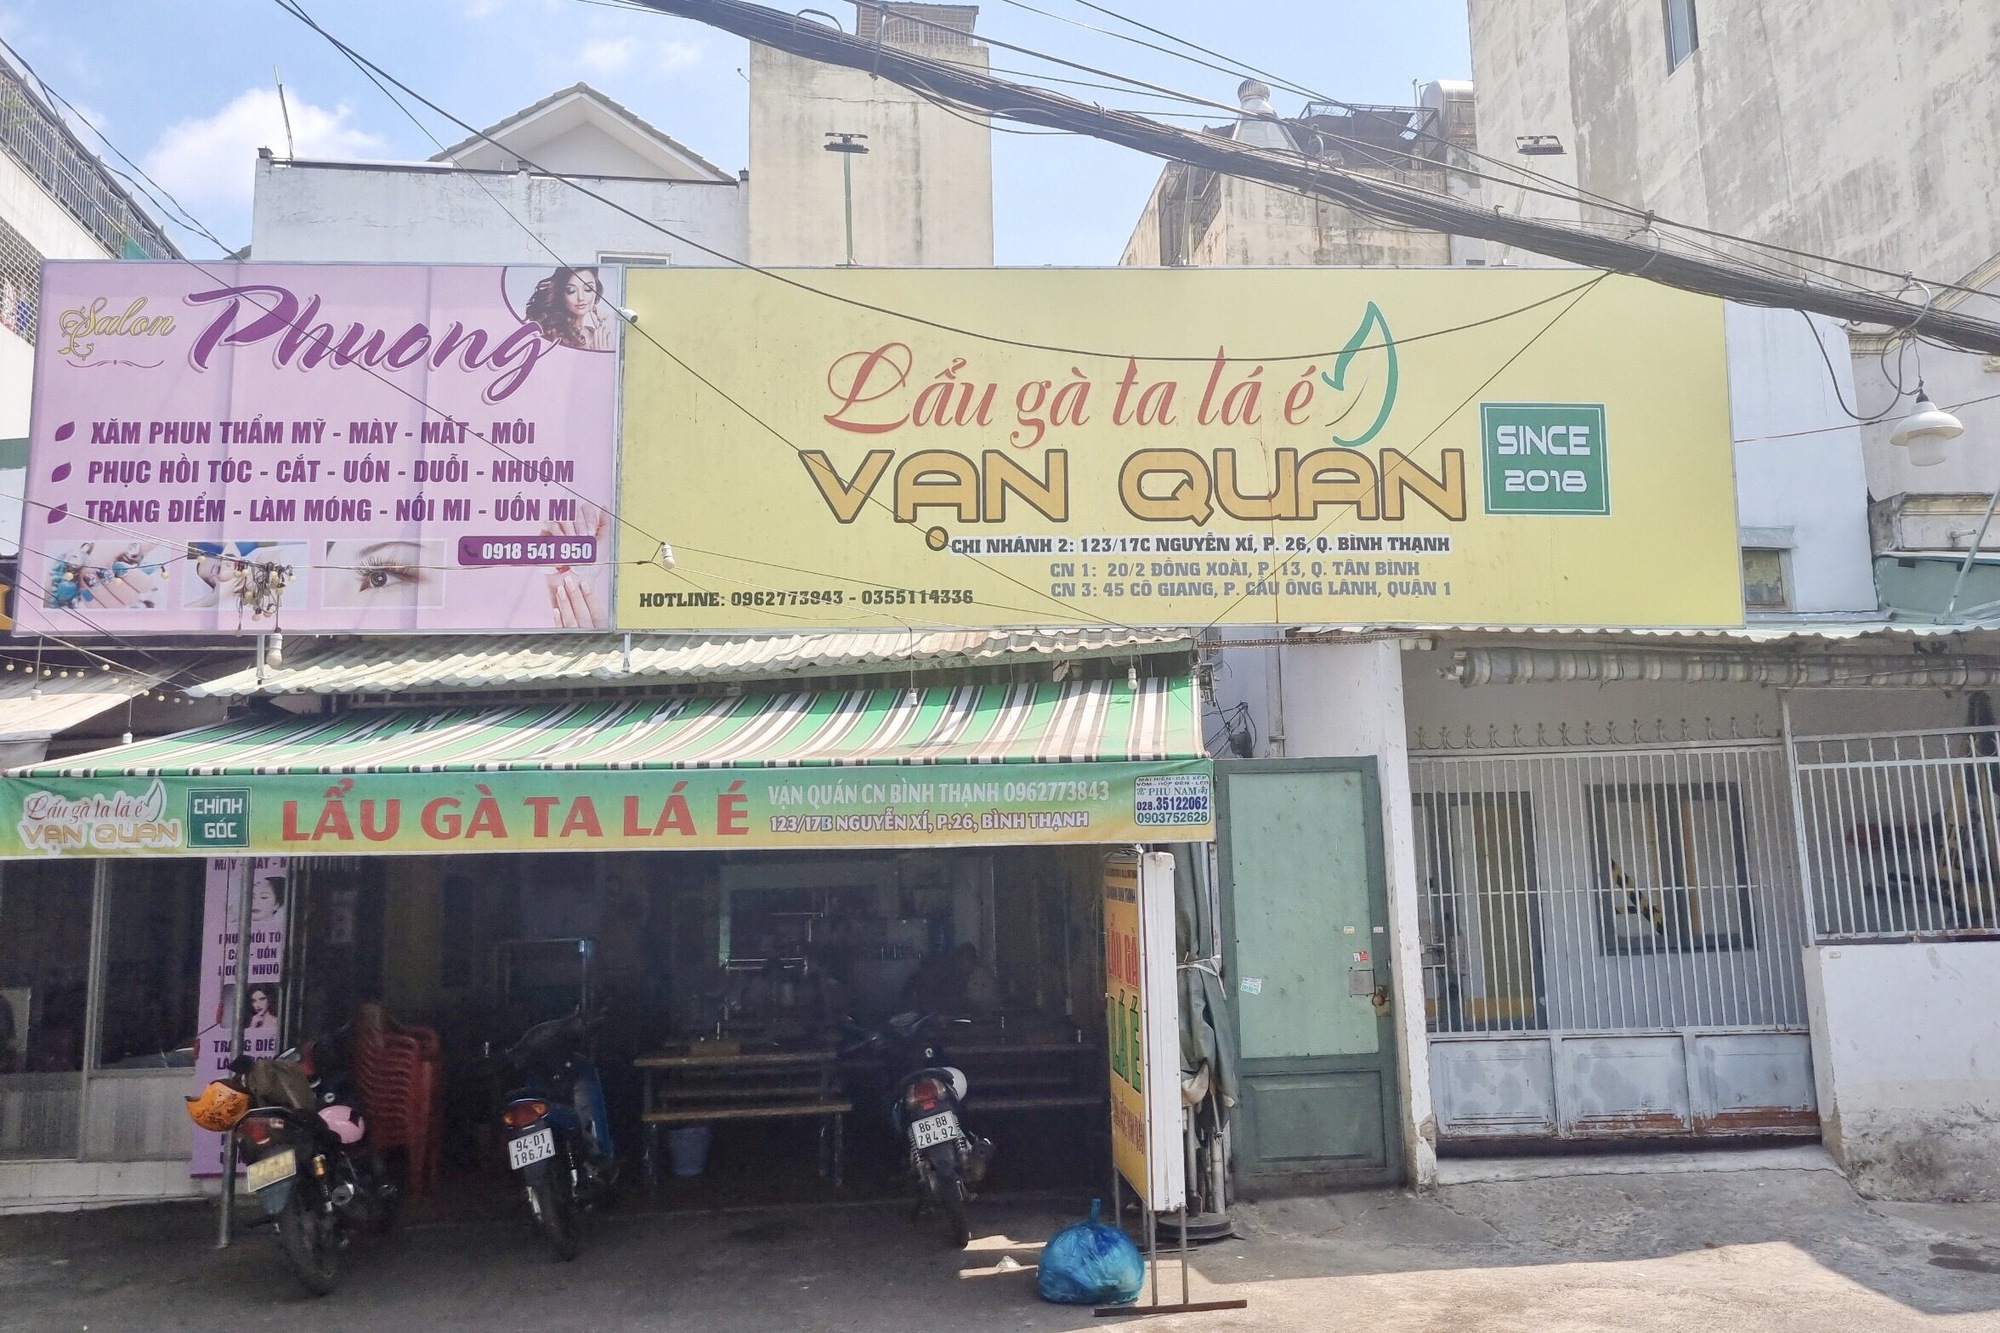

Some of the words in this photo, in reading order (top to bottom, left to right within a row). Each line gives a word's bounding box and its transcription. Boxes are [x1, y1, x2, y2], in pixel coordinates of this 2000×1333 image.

[58, 296, 177, 361] Salon
[184, 283, 559, 404] Phuong
[823, 341, 997, 434] Lẩu
[1009, 366, 1092, 449] gà
[1112, 354, 1178, 426] ta
[1196, 345, 1263, 426] lá
[1283, 364, 1317, 426] é
[90, 418, 142, 444] XĂM
[149, 421, 212, 444] PHUN
[219, 413, 284, 444] THẨM
[291, 418, 327, 444] MỸ
[349, 418, 399, 444] MÀY
[420, 414, 470, 444] MẮT
[491, 418, 536, 444] MÔI
[1496, 425, 1591, 456] SINCE
[87, 460, 152, 488] PHỤC
[159, 453, 200, 483] HỒI
[207, 456, 253, 483] TÓC
[275, 453, 321, 483] CẮT
[343, 452, 391, 483] UỐN
[413, 452, 469, 483] DUỖI
[491, 456, 575, 487] NHUỘM
[1504, 469, 1588, 493] 2018
[85, 500, 160, 523] TRANG
[168, 491, 227, 523] ĐIỂM
[249, 496, 297, 523] LÀM
[304, 495, 372, 522] MÓNG
[395, 491, 435, 522] NỐI
[442, 499, 472, 522] MI
[494, 491, 541, 522] UỐN
[547, 499, 577, 522] MI
[797, 447, 1070, 552] VẠN
[1118, 447, 1468, 526] QUAN
[482, 543, 522, 560] 0918
[527, 543, 556, 560] 541
[560, 543, 593, 560] 950
[951, 538, 981, 553] CHI
[986, 535, 1052, 553] NHÁNH
[1058, 538, 1075, 553] 2:
[1081, 538, 1151, 553] 123/17C
[1156, 532, 1230, 553] NGUYỄN
[1235, 533, 1258, 554] XÍ,
[1263, 537, 1279, 551] P.
[1285, 537, 1311, 553] 26,
[1316, 537, 1333, 553] Q.
[1338, 533, 1383, 551] BÌNH
[1387, 536, 1451, 554] THẠNH
[1050, 562, 1076, 577] CN
[1081, 562, 1097, 577] 1:
[1108, 561, 1146, 578] 20/2
[1151, 557, 1201, 577] ĐỒNG
[1206, 559, 1252, 579] XOÀI,
[1281, 561, 1306, 579] 13,
[1311, 561, 1328, 578] Q.
[1332, 559, 1371, 576] TÂN
[1375, 559, 1420, 576] BÌNH
[639, 591, 726, 608] HOTLINE:
[862, 589, 974, 605] 0355114336
[1050, 582, 1076, 597] CN
[1081, 582, 1098, 597] 3:
[1103, 582, 1125, 597] 45
[1130, 579, 1153, 597] CÔ
[1157, 582, 1219, 599] GIANG,
[1224, 582, 1240, 597] P.
[1246, 577, 1280, 597] CẦU
[1285, 579, 1324, 597] ÔNG
[1387, 578, 1438, 599] QUẬN
[1444, 581, 1452, 596] 1
[768, 784, 803, 810] VẠN
[807, 779, 858, 810] QUÁN
[861, 784, 886, 805] CN
[890, 778, 934, 804] BÌNH
[939, 782, 1000, 809] THẠNH
[1004, 780, 1110, 803] 0962773843
[1136, 795, 1208, 811] 028.35122062
[1173, 787, 1198, 796] NAM
[194, 795, 243, 815] CHÍNH
[282, 778, 400, 841] LẨU
[420, 783, 509, 841] GÀ
[523, 795, 605, 839] TA
[624, 780, 698, 836] LÁ
[716, 779, 751, 836] É
[204, 818, 238, 839] GỐC
[770, 814, 834, 834] 123/17B
[836, 806, 908, 833] NGUYỄN
[981, 807, 1026, 830] BÌNH
[1028, 811, 1090, 832] THẠNH
[1136, 811, 1209, 824] 0903752628
[22, 823, 84, 851] VẠN
[94, 822, 178, 845] QUAN
[918, 1125, 958, 1147] 284.92
[513, 1143, 552, 1166] 186.74
